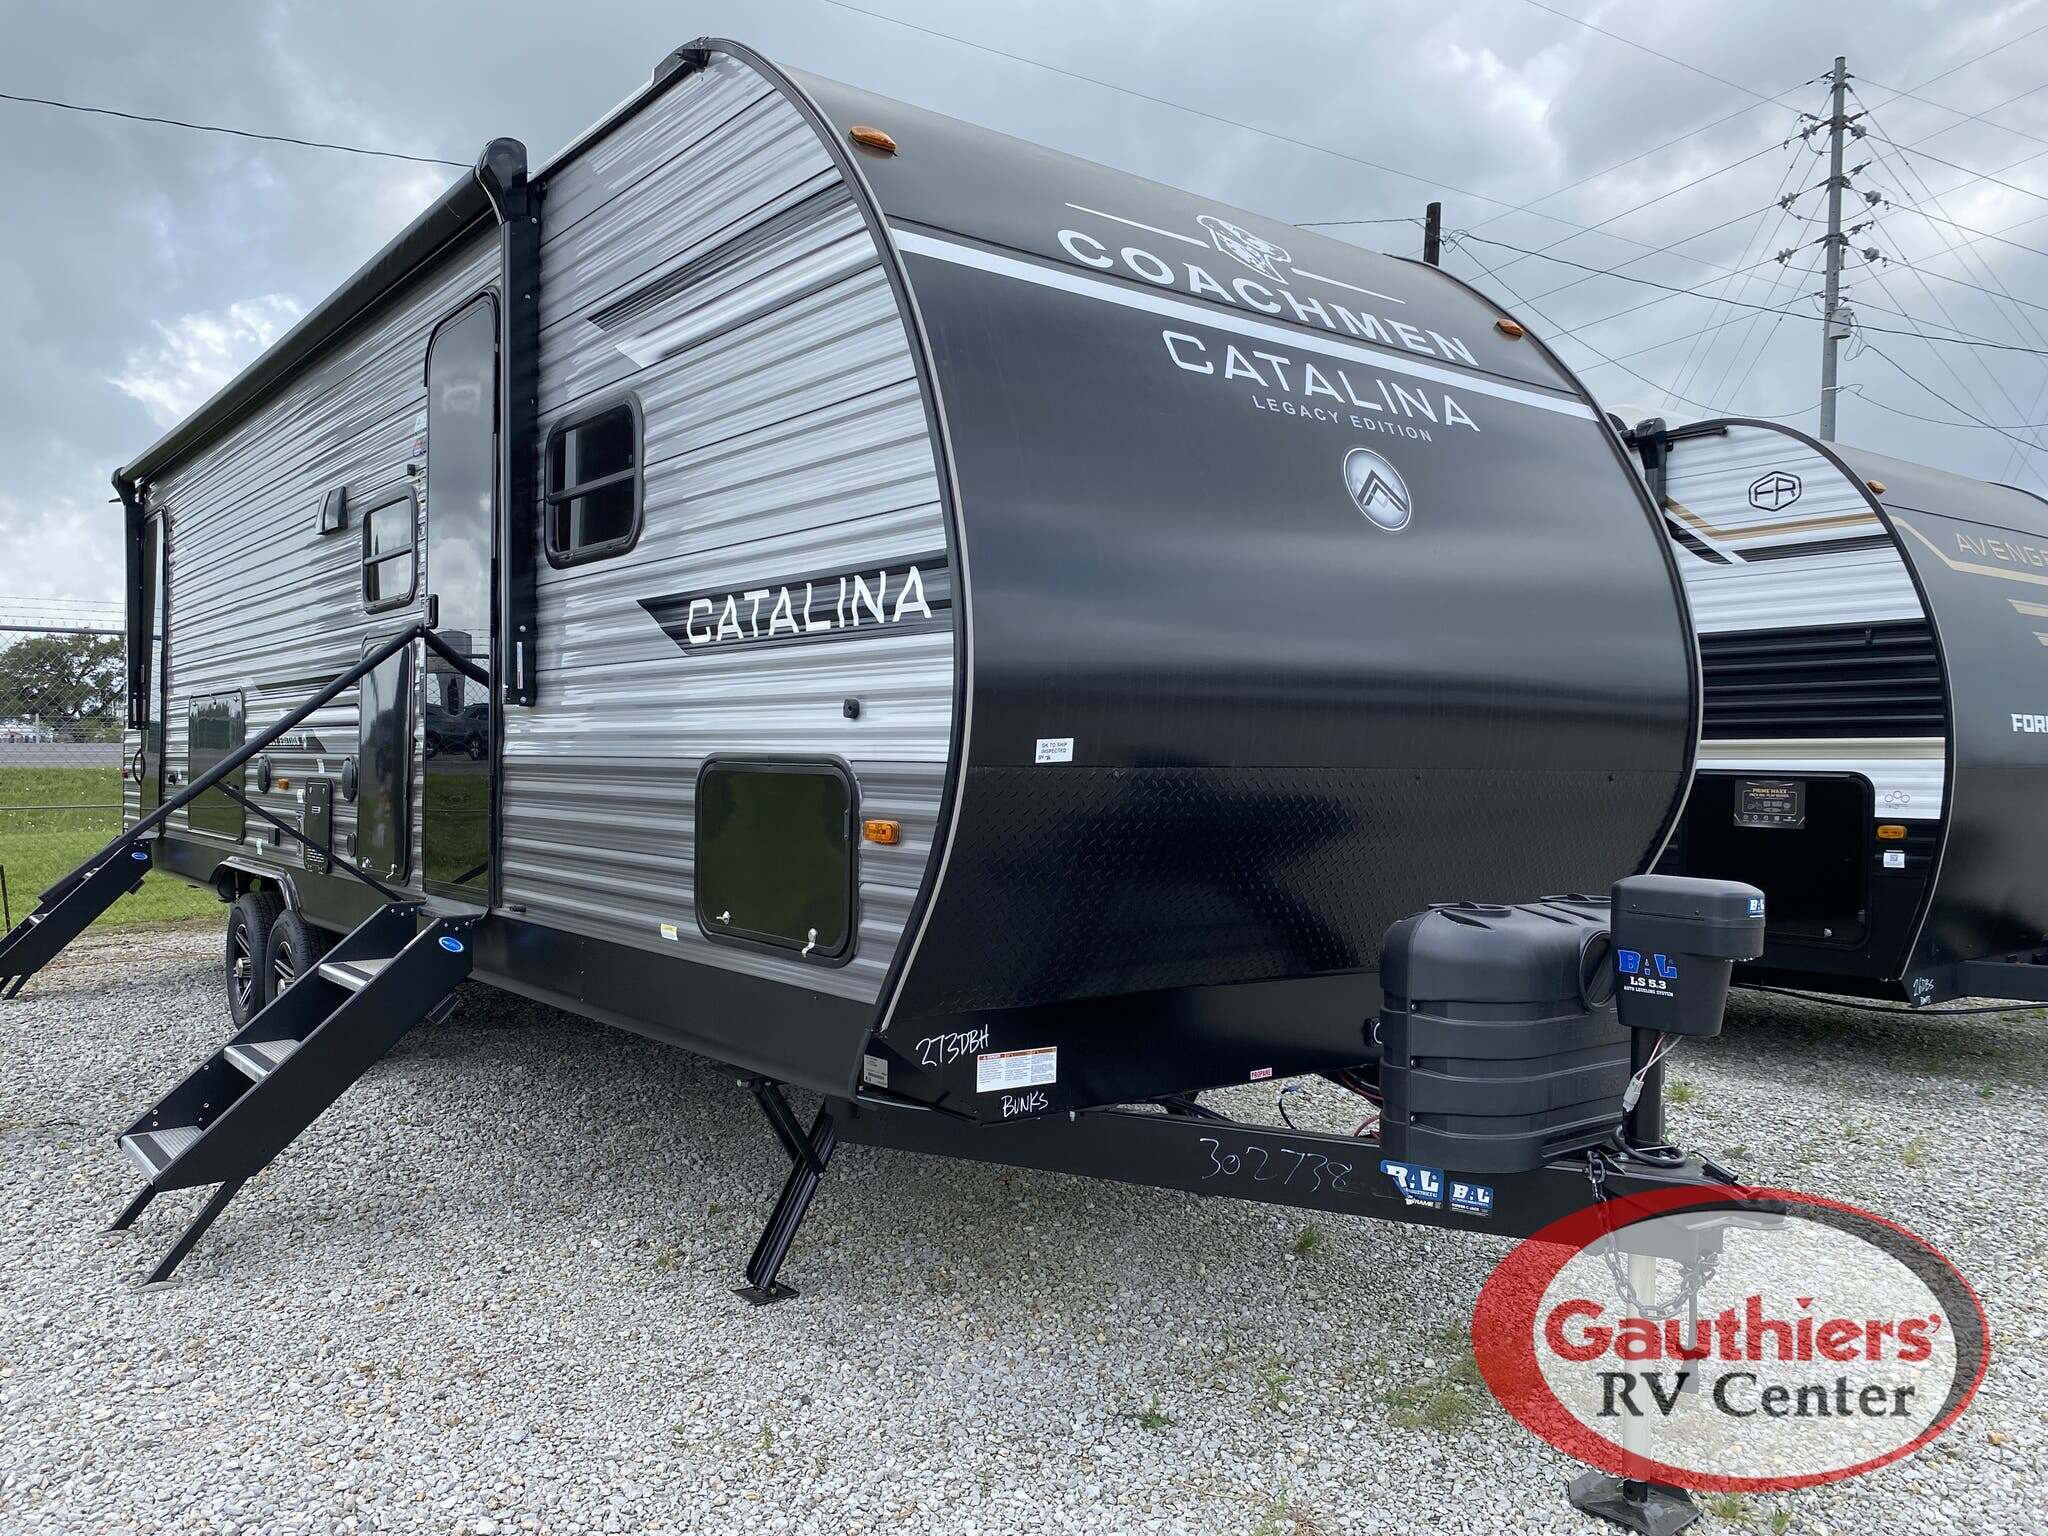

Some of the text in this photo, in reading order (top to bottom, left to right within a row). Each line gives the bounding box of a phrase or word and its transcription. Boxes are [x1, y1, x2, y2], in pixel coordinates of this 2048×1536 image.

[1057, 229, 1479, 366] COACHMEN
[1162, 329, 1480, 432] CATALINA
[1252, 395, 1432, 442] LEGACY EDITION
[686, 566, 932, 644] CATALINA
[2010, 713, 2048, 733] FOR
[1630, 976, 1667, 990] LS 5.3
[1251, 1069, 1271, 1079] PROPANE
[1001, 1091, 1049, 1118] BUNKS
